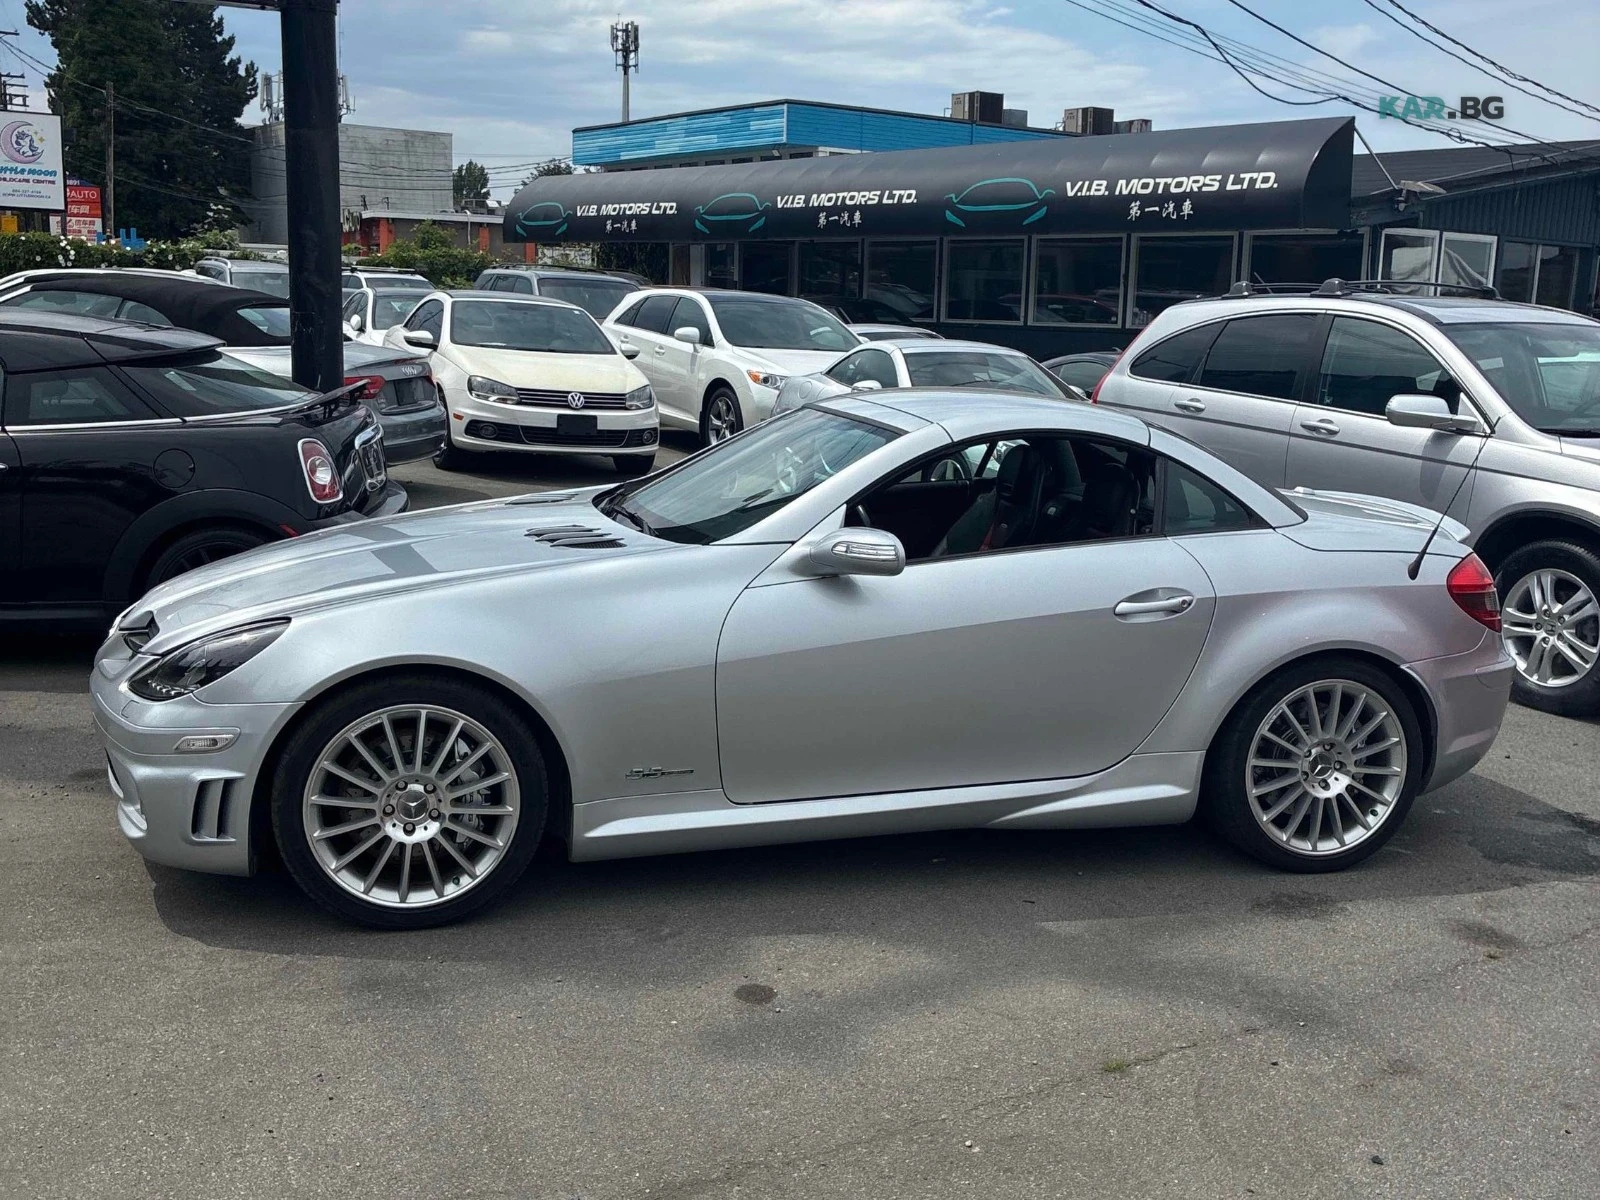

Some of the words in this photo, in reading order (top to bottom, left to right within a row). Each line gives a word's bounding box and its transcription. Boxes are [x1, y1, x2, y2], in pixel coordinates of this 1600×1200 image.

[1066, 181, 1109, 197] V.I.B.
[1115, 175, 1222, 195] MOTORS
[1225, 171, 1278, 190] LTD.
[70, 190, 97, 199] AUTO
[776, 195, 806, 208] V.I.B.
[809, 190, 881, 207] MOTORS
[882, 189, 918, 204] LTD.
[68, 205, 90, 215] 车网
[576, 205, 598, 217] V.I.B.
[599, 202, 651, 216] MOTORS
[651, 202, 678, 214] LTD.
[1127, 198, 1194, 221] 第一汽車
[605, 218, 638, 233] 第一汽車
[817, 210, 862, 229] 第一汽車
